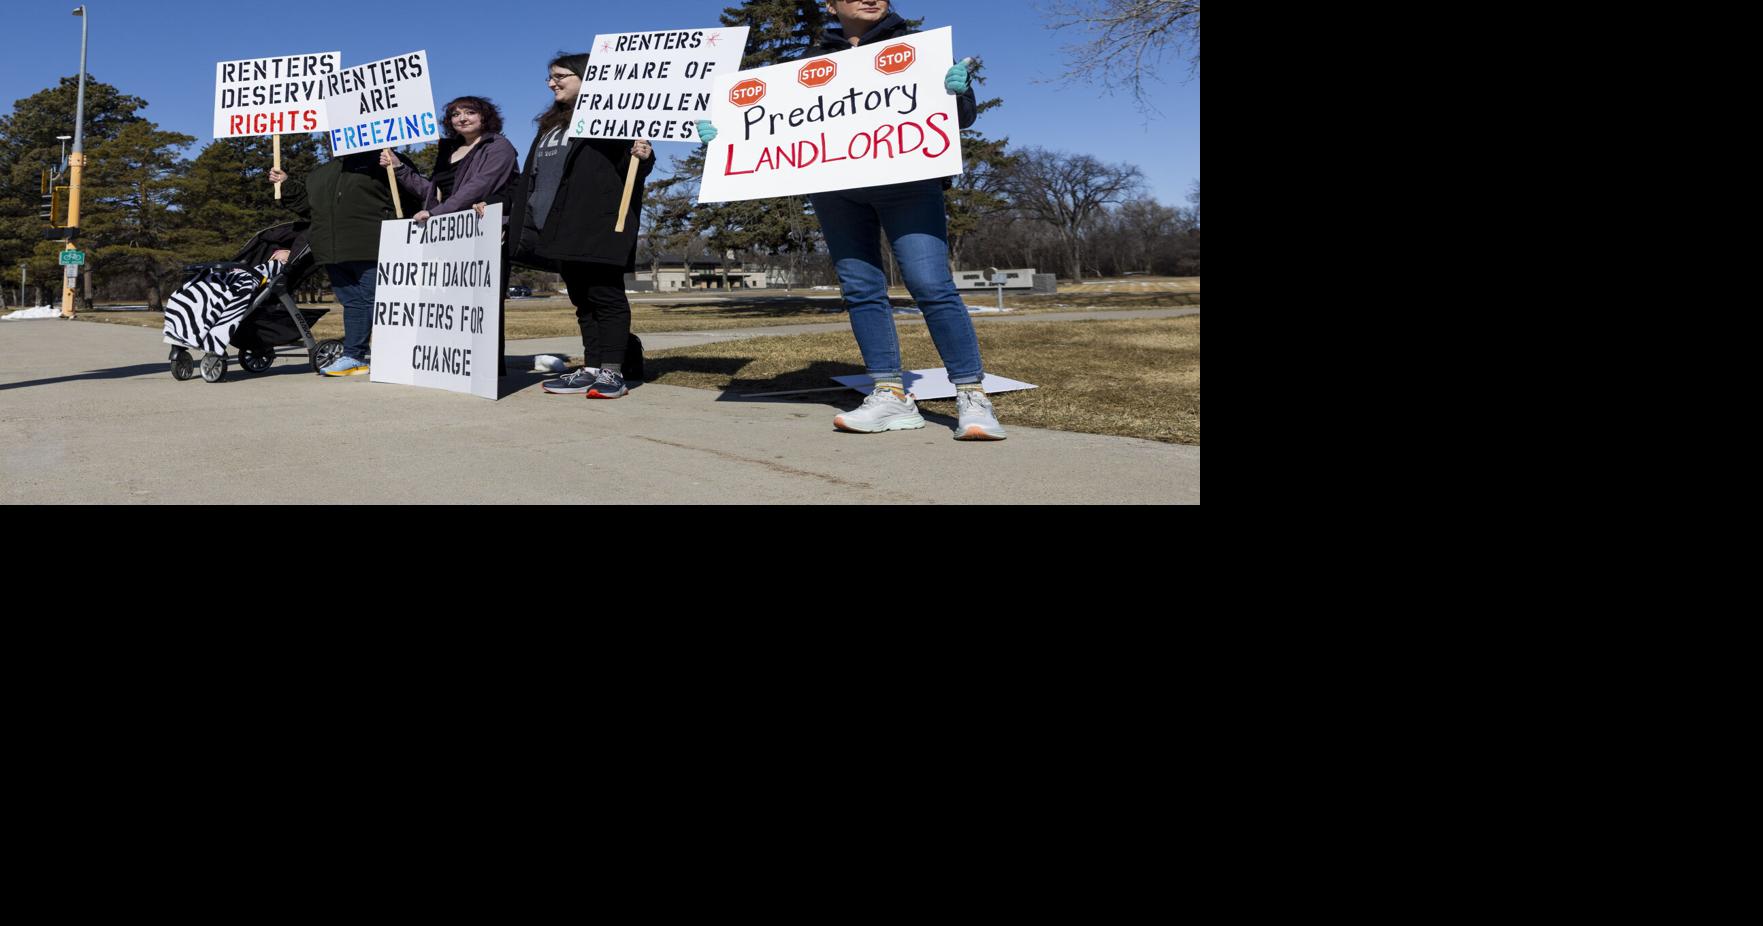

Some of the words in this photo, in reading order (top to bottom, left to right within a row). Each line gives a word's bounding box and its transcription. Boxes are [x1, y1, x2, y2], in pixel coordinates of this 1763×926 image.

[615, 31, 704, 52] RENTERS
[222, 54, 334, 83] RENTERS
[585, 61, 671, 82] BEWARE
[684, 61, 716, 80] OF
[802, 65, 833, 81] STOP
[879, 51, 911, 67] STOP
[327, 54, 423, 97] RENTERS
[359, 85, 399, 115] ARE
[576, 93, 711, 111] FRAUDULEN
[732, 85, 763, 100] STOP
[229, 109, 318, 135] RIGHTS
[744, 83, 917, 140] Predatory
[331, 111, 436, 151] FREEZING
[589, 119, 695, 139] CHARGES
[723, 112, 951, 176] LANDLORDS
[377, 262, 437, 287] NORTH
[442, 260, 491, 288] DAKOTA
[374, 301, 453, 331] RENTERS
[460, 305, 484, 335] FOR
[412, 345, 472, 377] CHANGE
